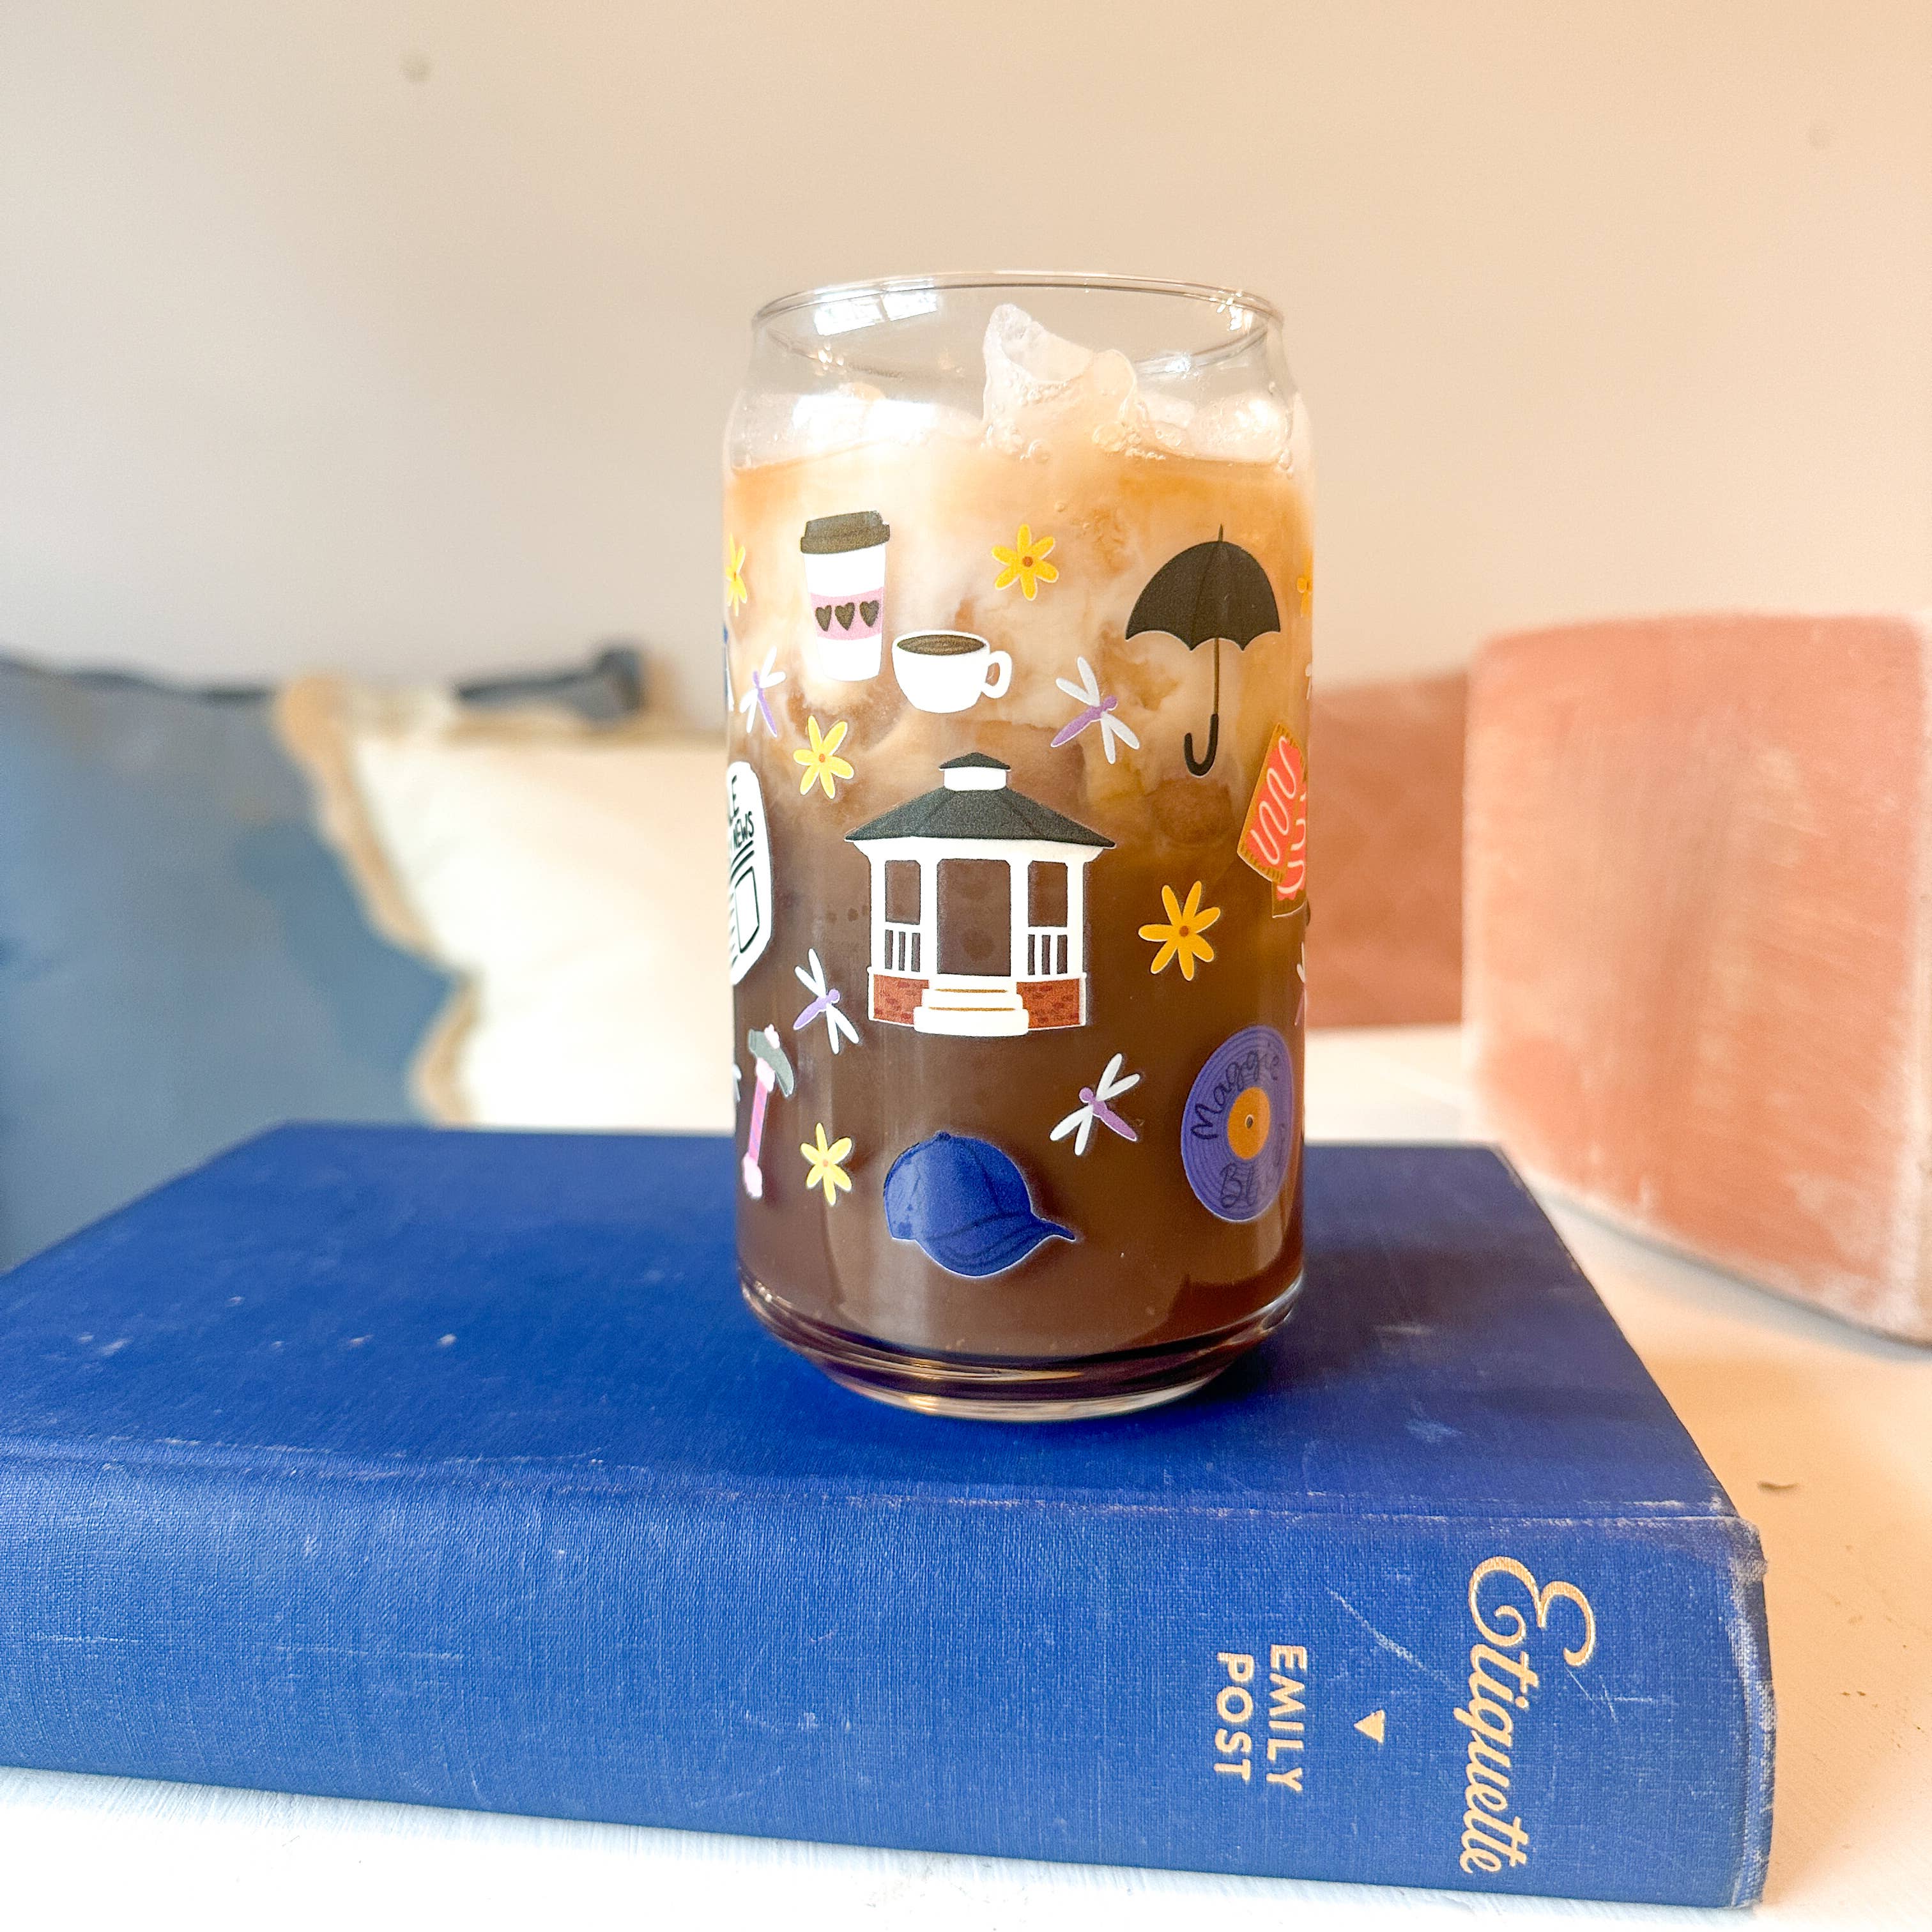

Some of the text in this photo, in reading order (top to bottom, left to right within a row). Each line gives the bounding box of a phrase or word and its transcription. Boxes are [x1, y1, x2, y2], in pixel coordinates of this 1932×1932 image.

[1215, 1653, 1254, 1781] POST
[1267, 1645, 1307, 1791] EMILY
[1453, 1556, 1595, 1873] Etiquette
